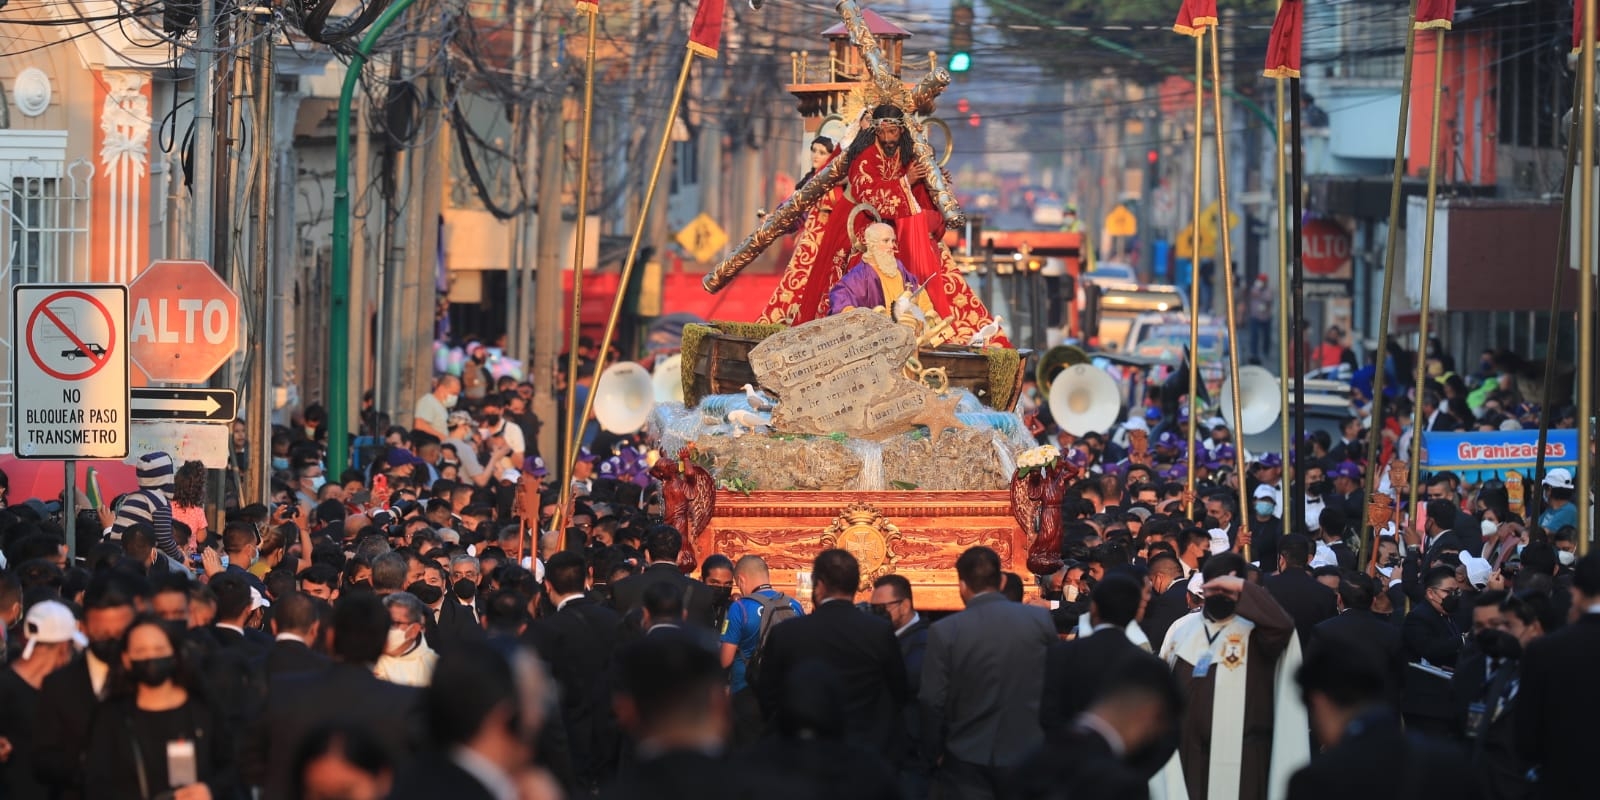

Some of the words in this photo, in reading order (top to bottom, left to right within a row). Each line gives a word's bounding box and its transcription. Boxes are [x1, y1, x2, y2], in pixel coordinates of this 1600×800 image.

[1302, 234, 1347, 258] ALTO
[130, 298, 229, 345] ALTO
[788, 350, 807, 362] este
[817, 331, 852, 351] mundo
[63, 388, 81, 403] NO
[786, 404, 803, 416] Yo
[807, 399, 820, 409] he
[826, 381, 865, 401] venido
[871, 372, 880, 384] al
[800, 381, 822, 398] pero
[26, 409, 84, 424] BLOQUEAR
[90, 409, 117, 423] PASO
[28, 429, 117, 444] TRANSMETRO
